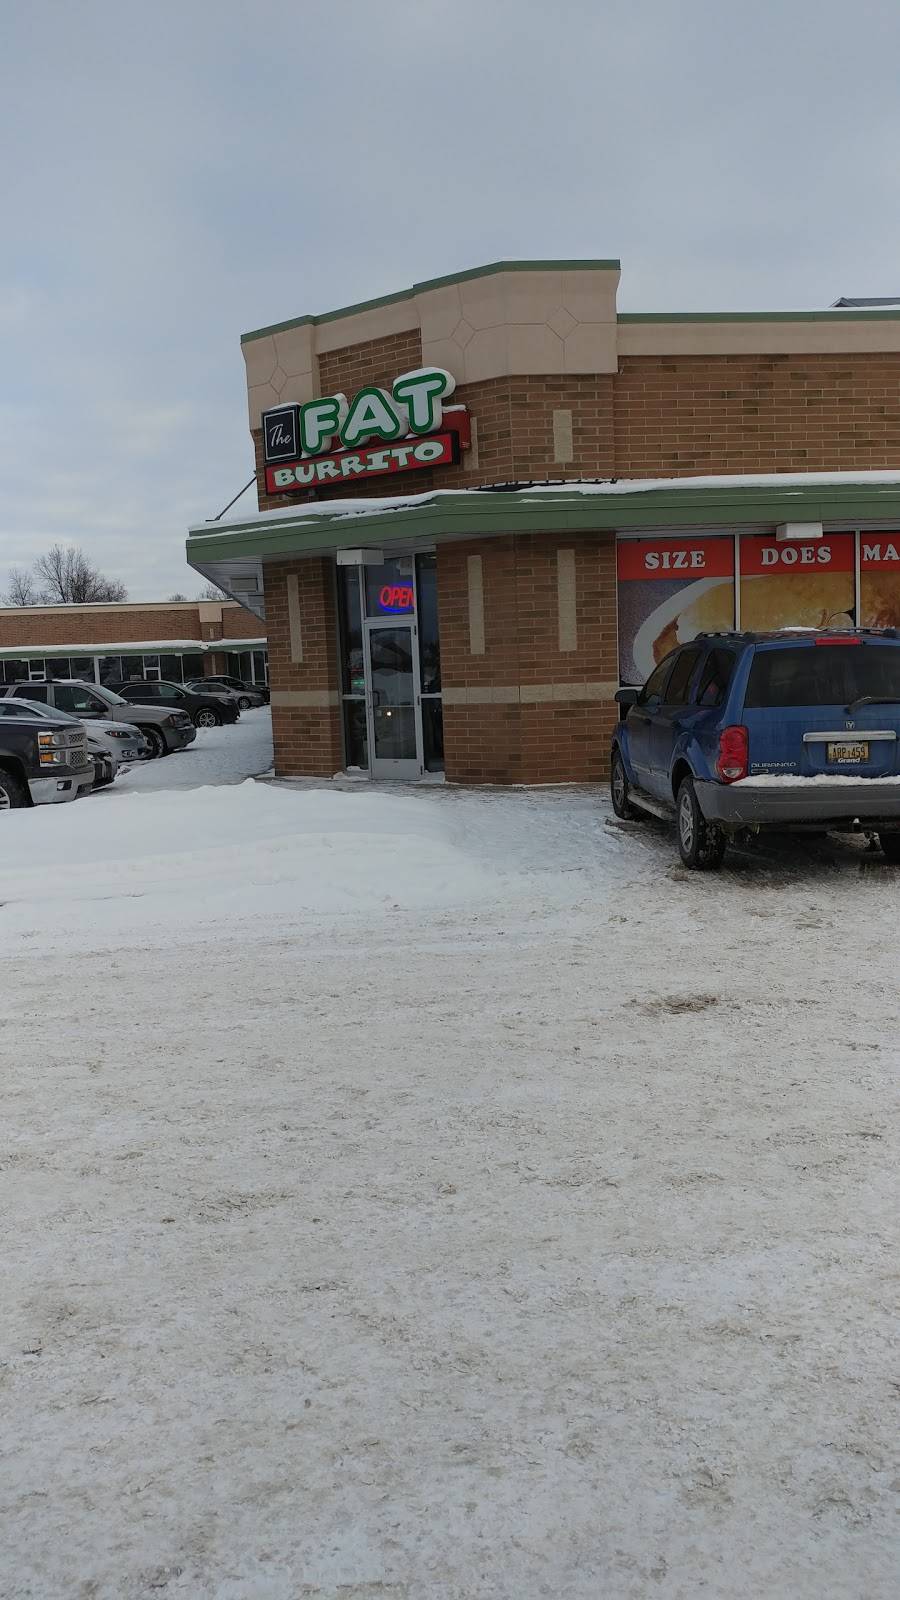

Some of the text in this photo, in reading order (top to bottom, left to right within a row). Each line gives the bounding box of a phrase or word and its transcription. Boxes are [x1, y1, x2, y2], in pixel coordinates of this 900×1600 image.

[300, 373, 446, 454] FAT
[269, 423, 291, 447] The
[274, 441, 443, 487] BURRITO
[644, 551, 706, 570] SIZE
[761, 546, 831, 566] DOES
